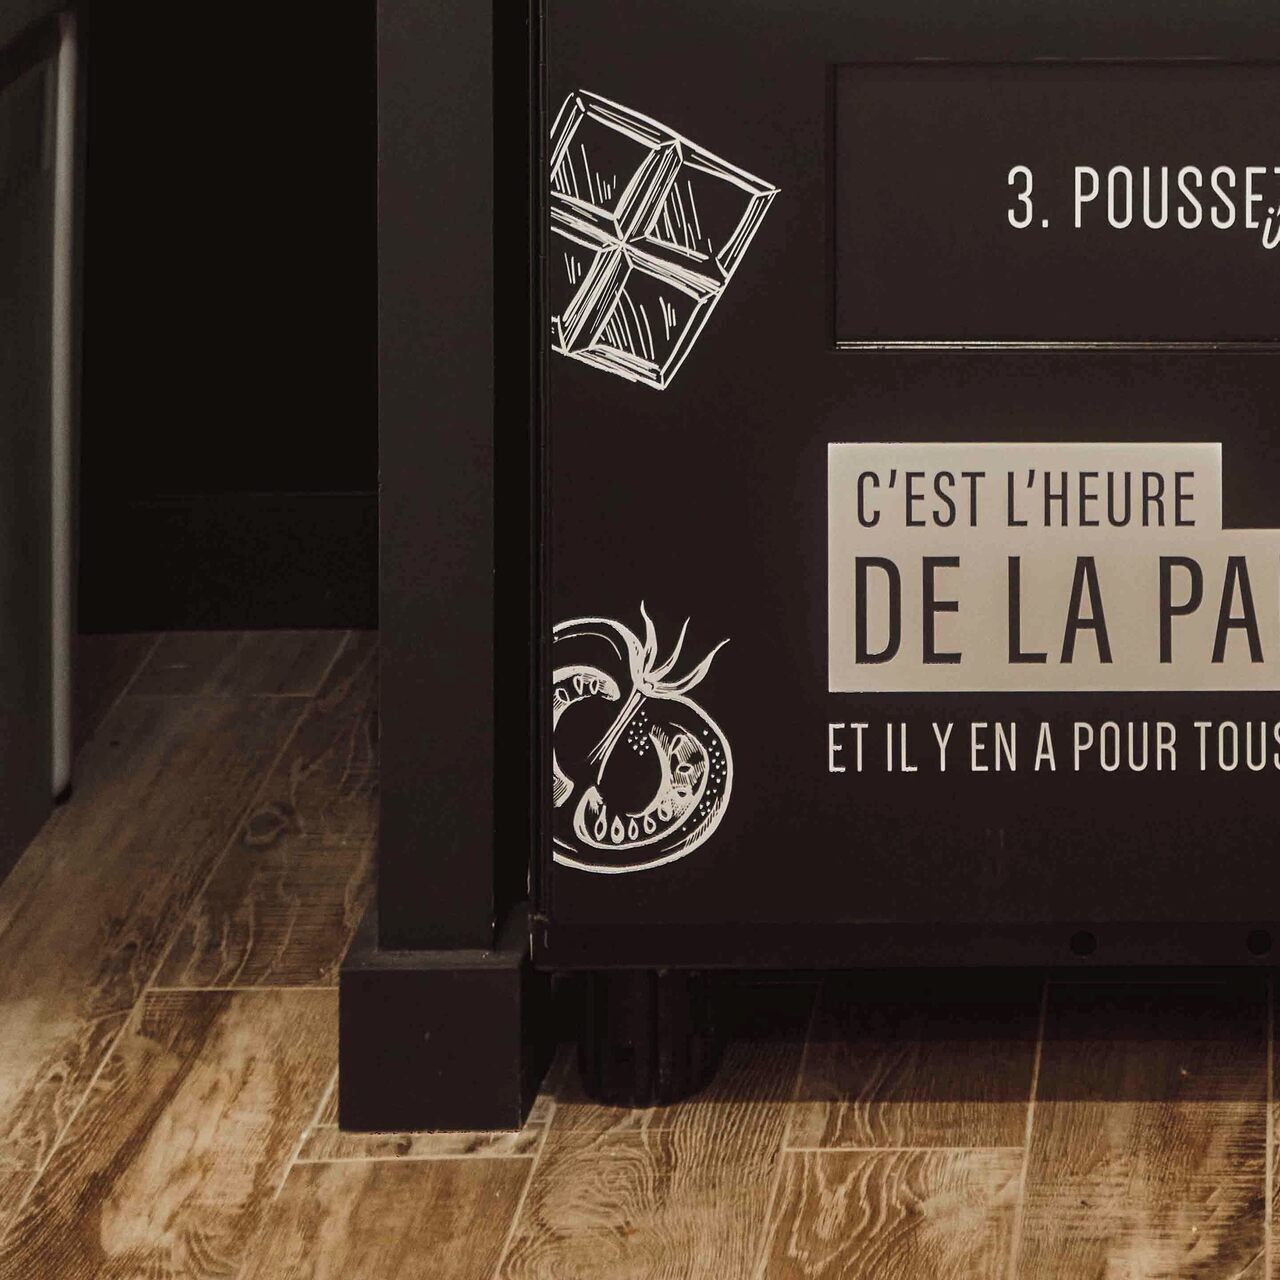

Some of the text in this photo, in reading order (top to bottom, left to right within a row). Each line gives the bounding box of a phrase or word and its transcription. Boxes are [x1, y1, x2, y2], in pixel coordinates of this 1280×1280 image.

[1007, 164, 1049, 229] 3.
[856, 469, 1197, 529] C'EST L'HEURE
[854, 555, 963, 665] DE
[1007, 555, 1114, 665] LA
[828, 722, 870, 773] ET
[886, 722, 919, 773] IL
[931, 722, 954, 772] Y
[970, 722, 1018, 772] EN
[1033, 722, 1058, 772] A
[1073, 721, 1178, 772] POUR
